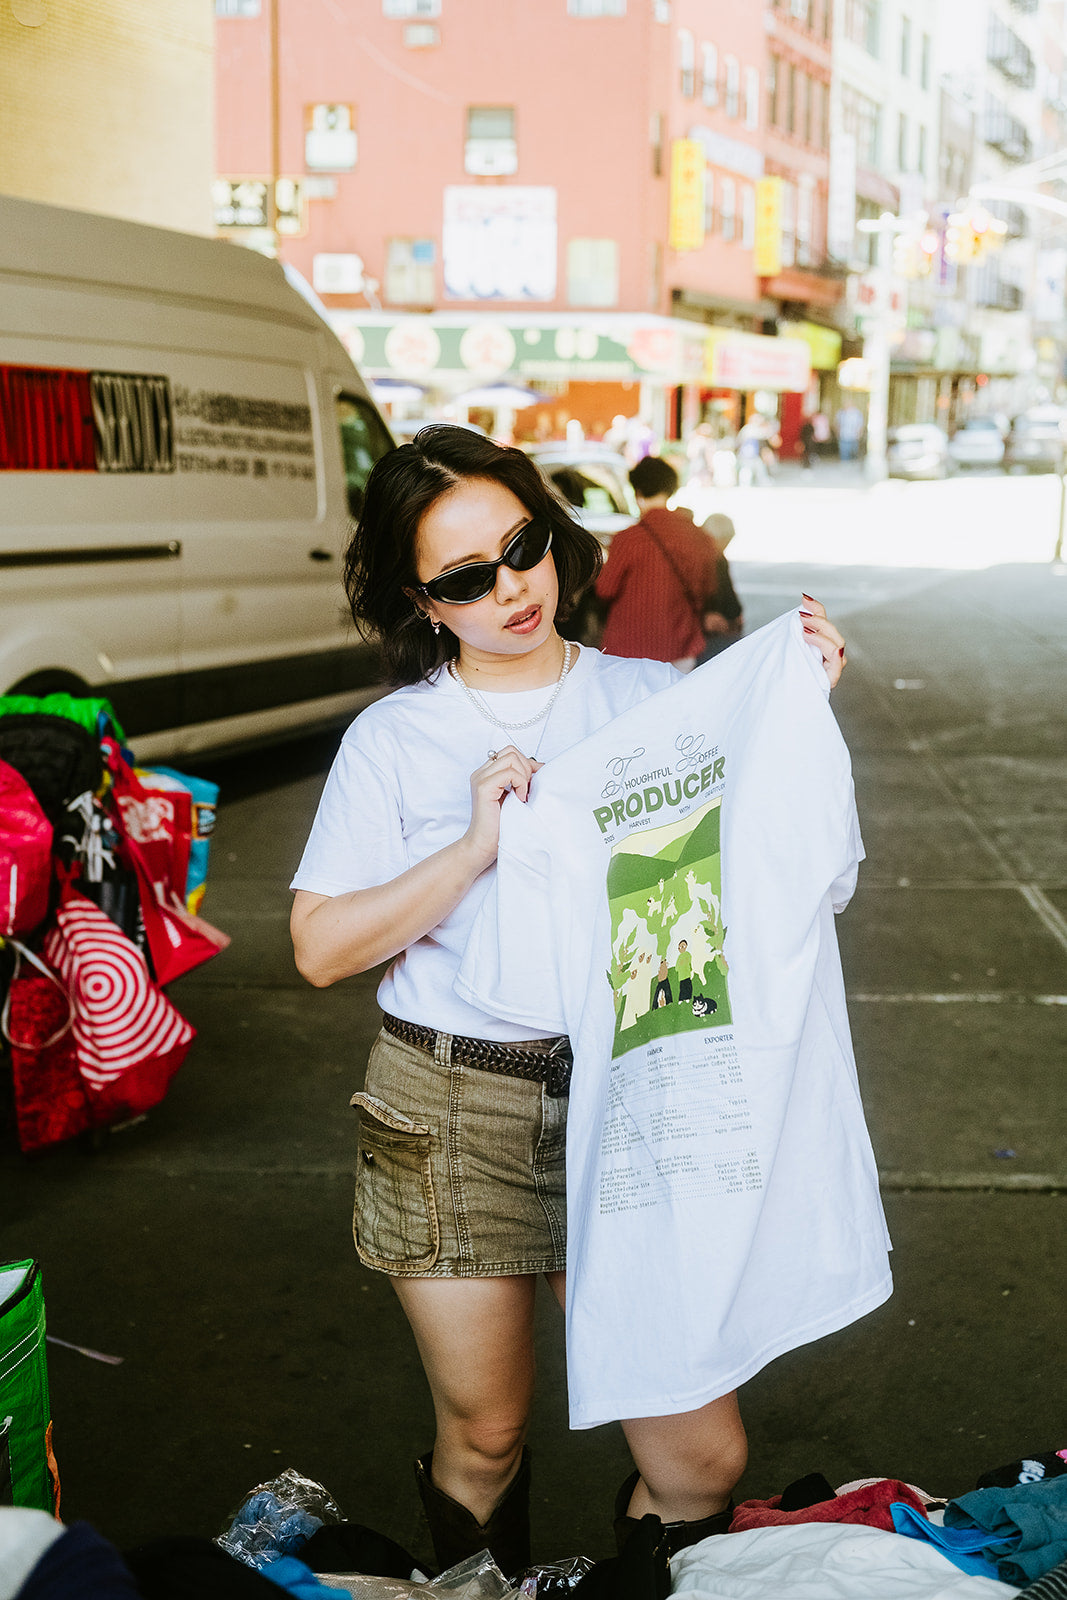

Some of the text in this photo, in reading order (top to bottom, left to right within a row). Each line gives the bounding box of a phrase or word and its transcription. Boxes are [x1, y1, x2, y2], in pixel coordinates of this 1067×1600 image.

[600, 733, 719, 799] THOUGHTFUL COFFEE
[593, 756, 726, 834] PRODUCER
[629, 817, 652, 829] HARVEST
[704, 1033, 735, 1045] EXPORTER
